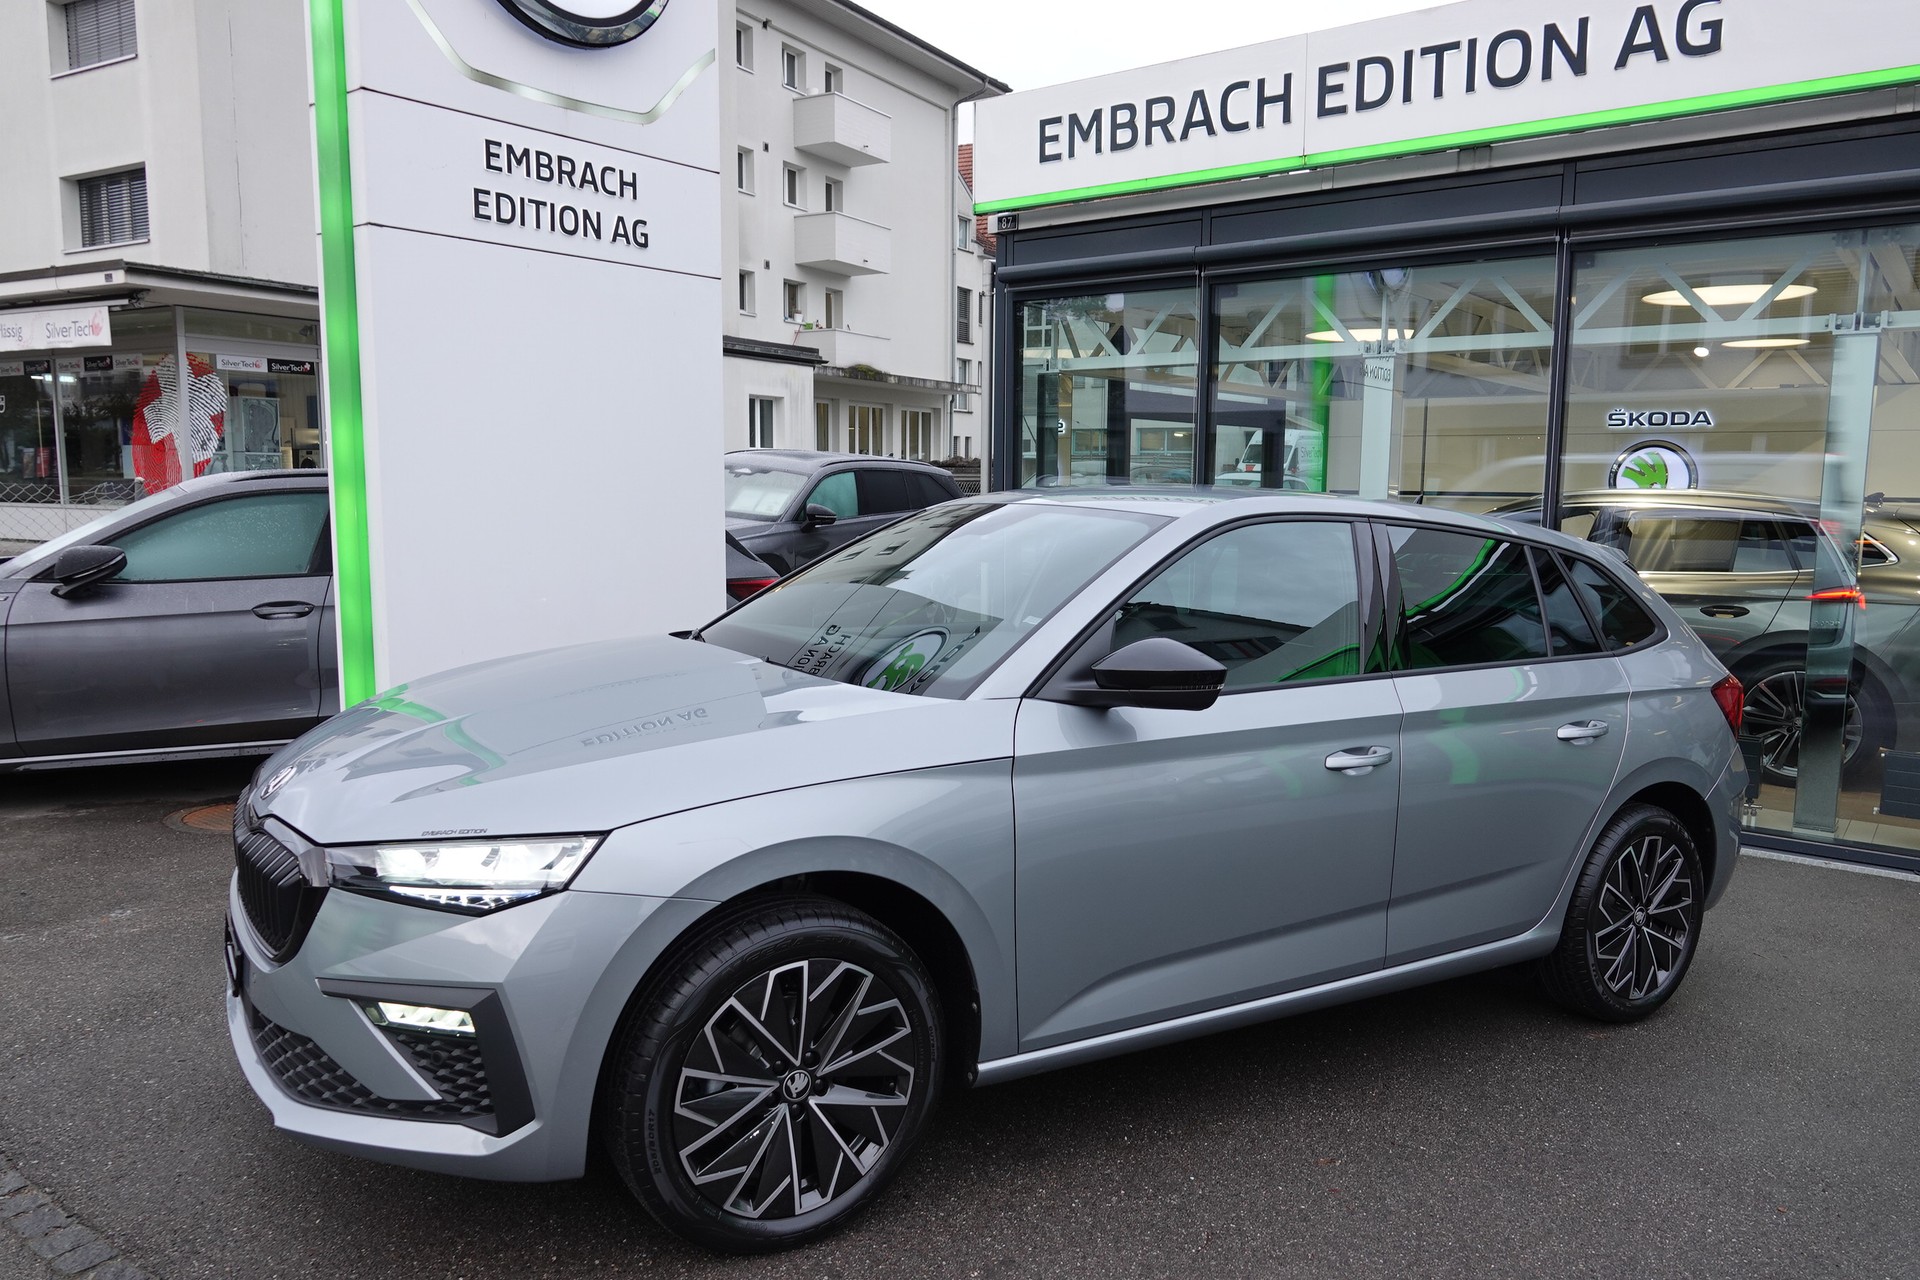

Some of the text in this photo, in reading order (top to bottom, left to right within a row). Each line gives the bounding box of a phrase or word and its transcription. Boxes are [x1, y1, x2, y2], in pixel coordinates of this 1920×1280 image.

[1039, 0, 1724, 164] EMBRACH EDITION AG
[484, 138, 638, 200] EMBRACH
[473, 187, 649, 249] EDITION AG
[1001, 216, 1012, 229] 87
[0, 323, 23, 342] lässig
[1607, 408, 1713, 427] ŠKODA
